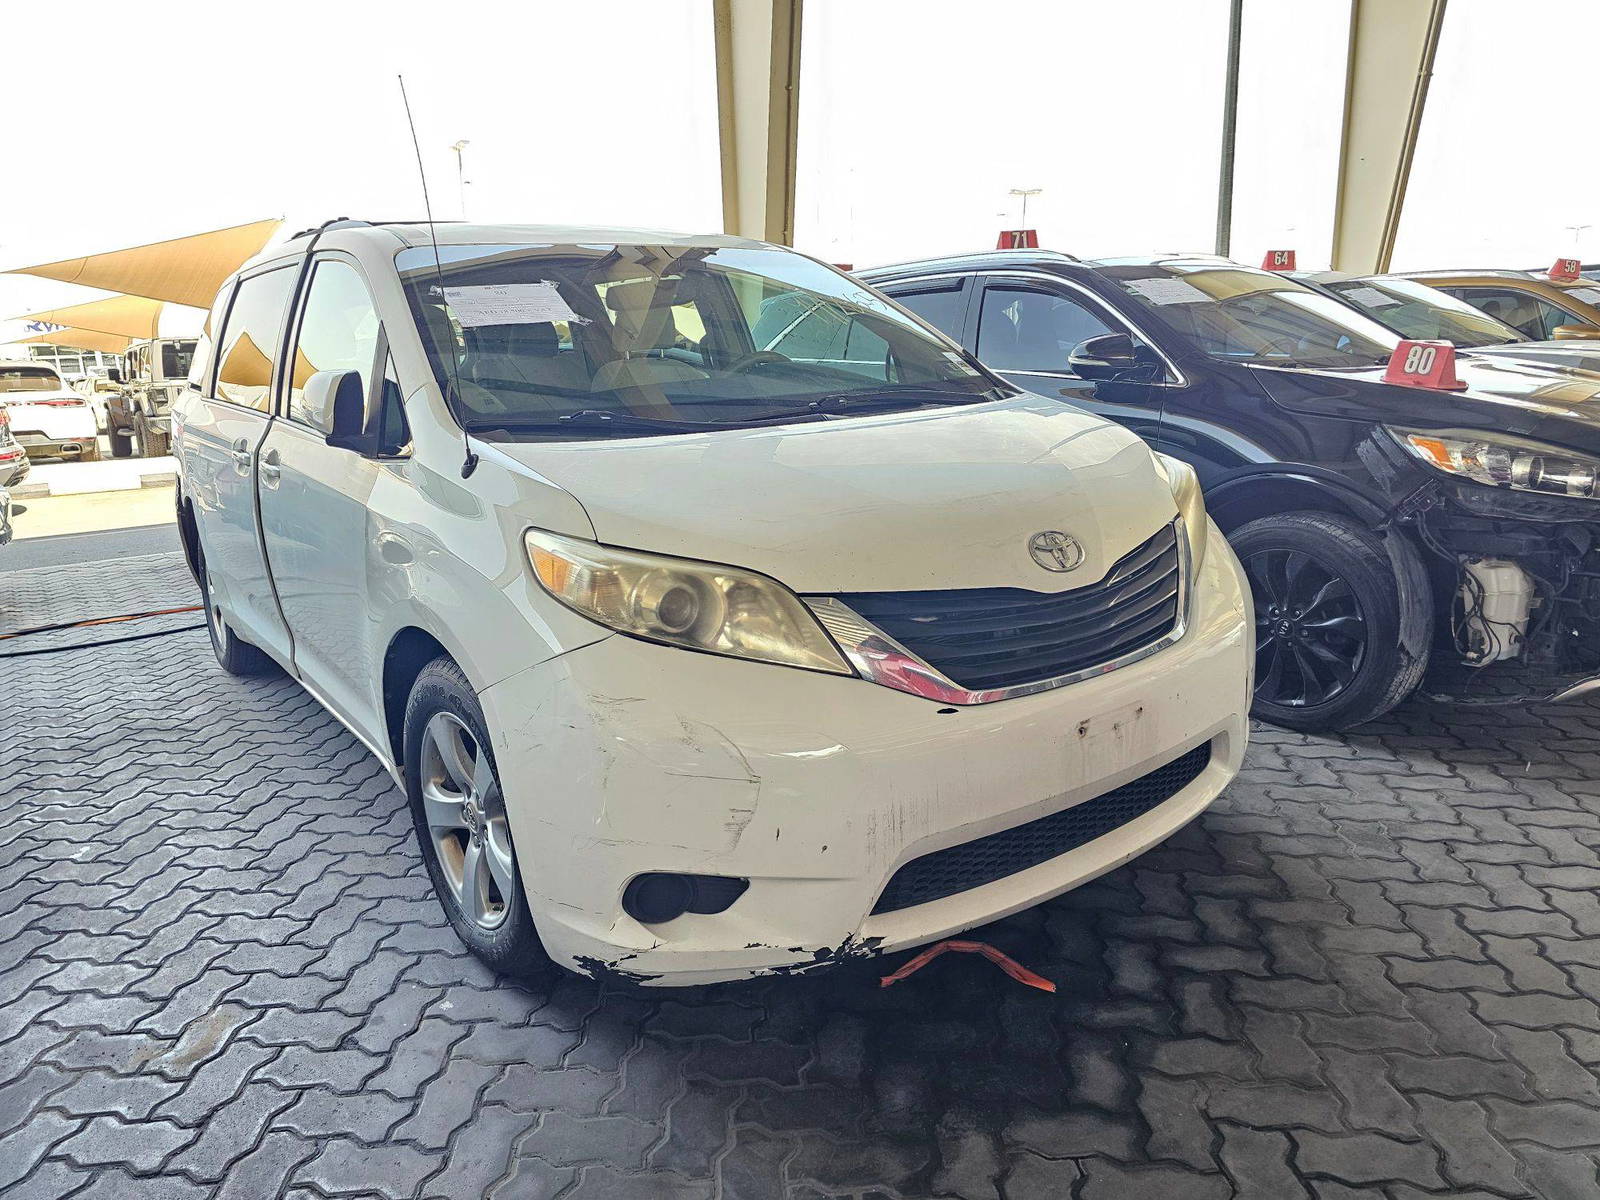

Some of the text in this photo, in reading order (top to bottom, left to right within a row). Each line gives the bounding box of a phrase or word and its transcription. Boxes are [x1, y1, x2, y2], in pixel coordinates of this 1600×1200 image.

[1011, 231, 1028, 249] 71
[1274, 251, 1289, 265] 64
[1564, 260, 1577, 273] 58
[1403, 345, 1436, 375] 80
